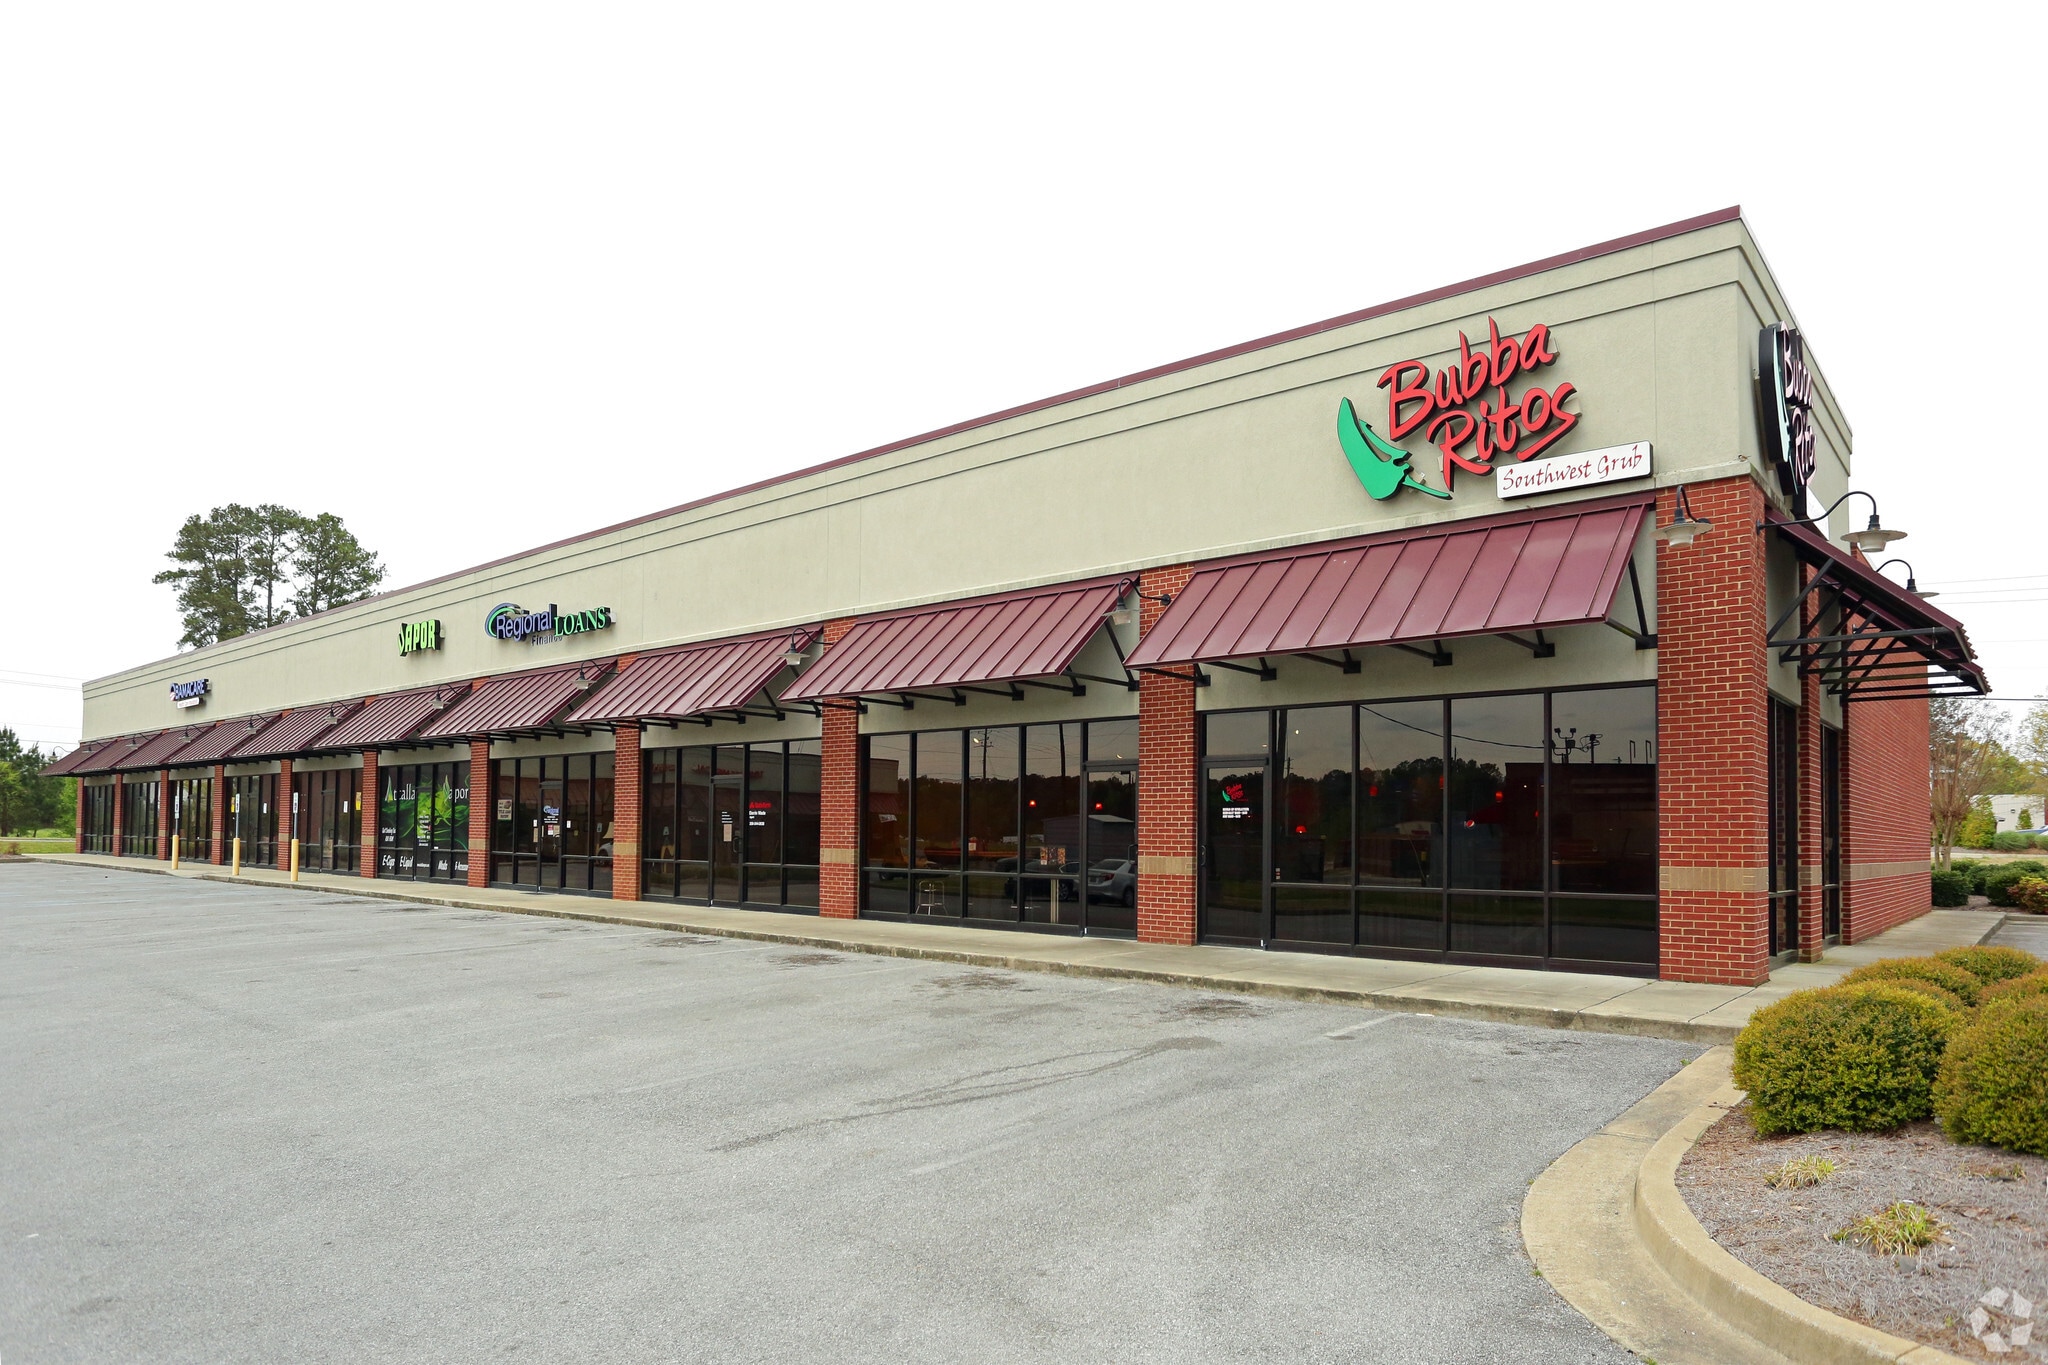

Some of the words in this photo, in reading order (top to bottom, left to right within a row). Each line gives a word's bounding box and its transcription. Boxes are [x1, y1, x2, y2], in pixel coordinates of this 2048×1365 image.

[1377, 316, 1554, 441] Bubba
[1426, 382, 1577, 492] Ritos
[1503, 460, 1592, 490] Southwest
[1598, 445, 1642, 479] Grub
[397, 618, 437, 656] VAPOR
[495, 603, 552, 642] Regional
[554, 607, 607, 637] LOANS
